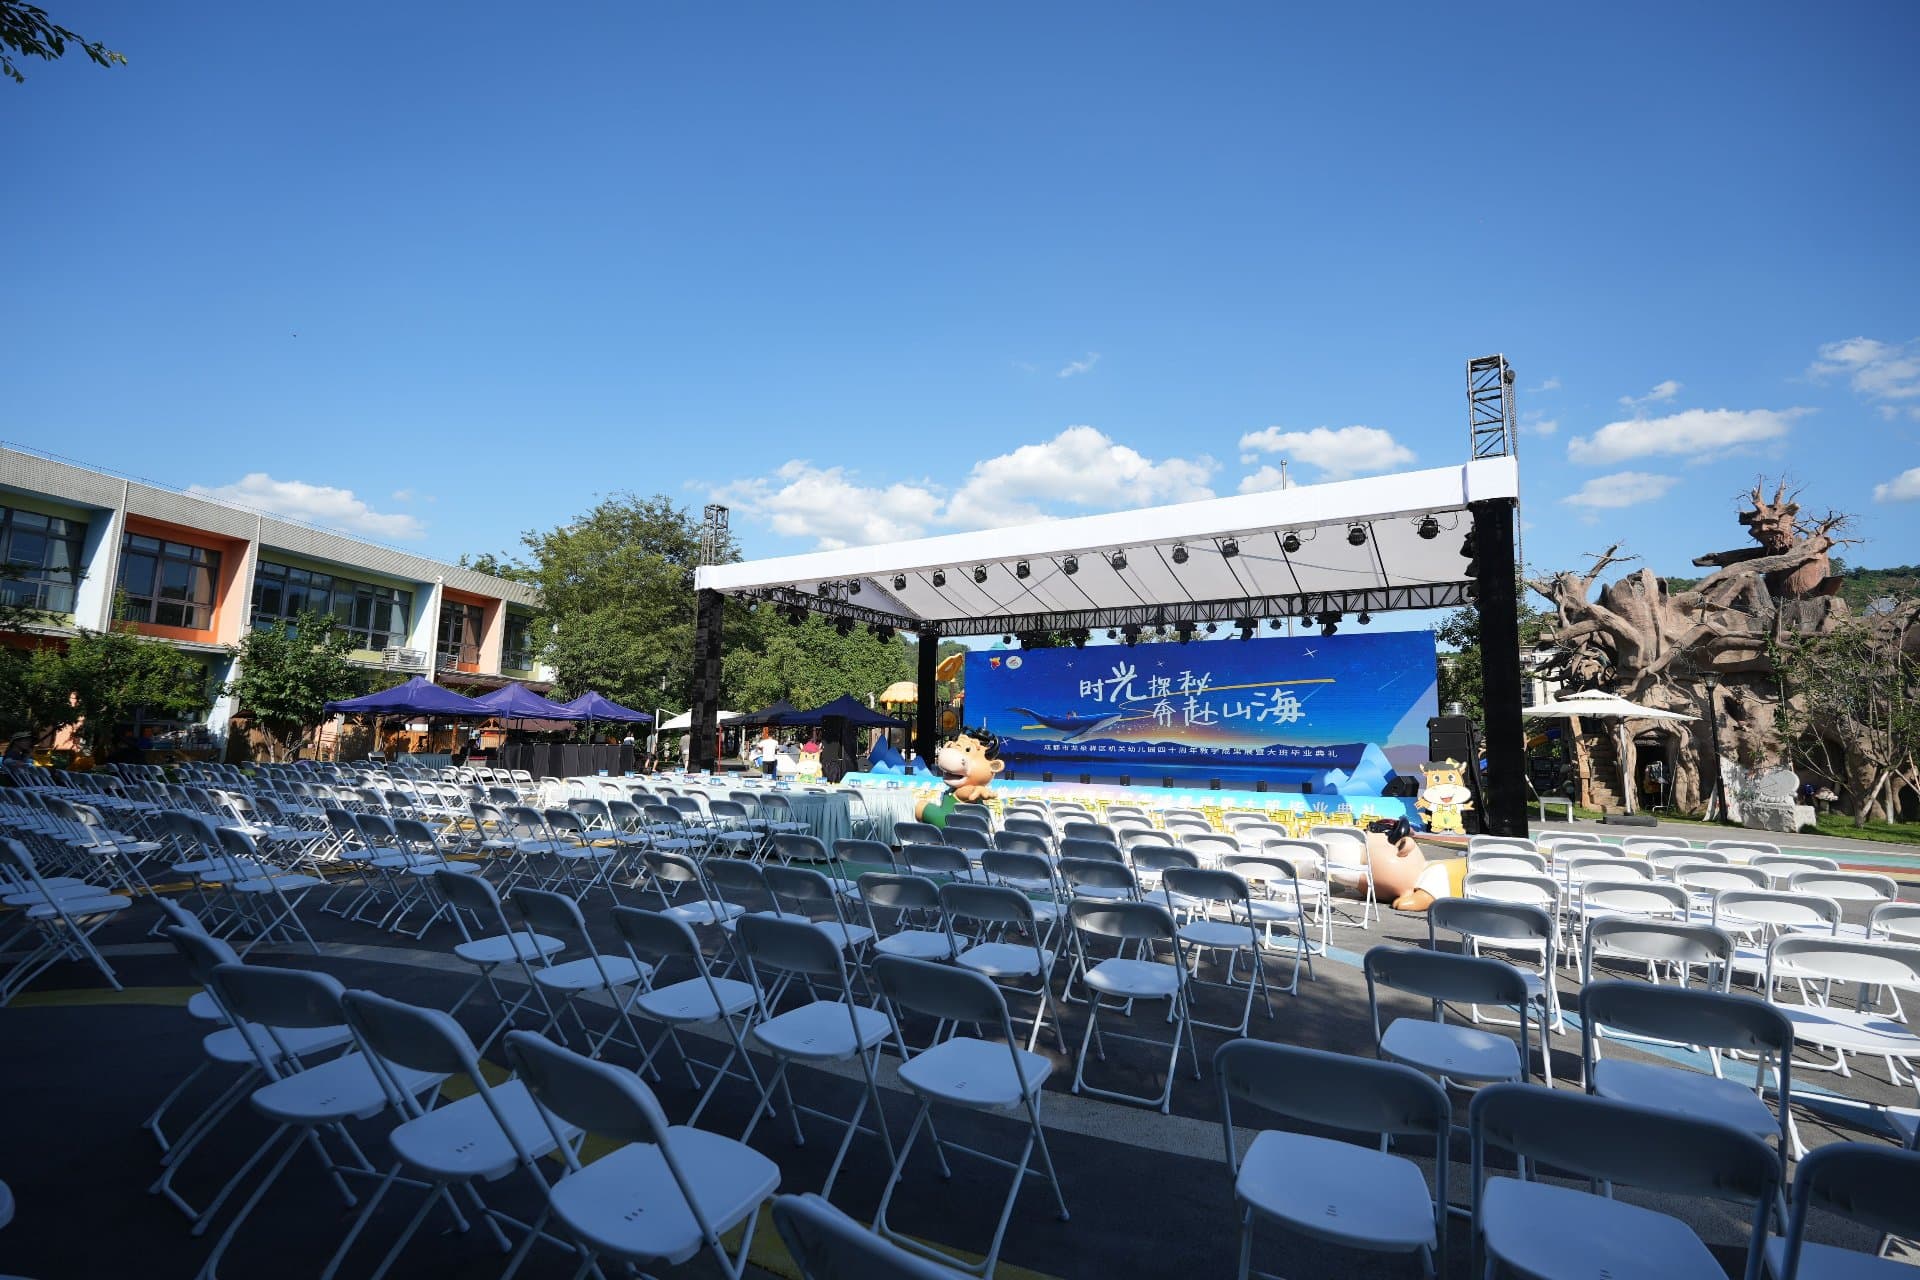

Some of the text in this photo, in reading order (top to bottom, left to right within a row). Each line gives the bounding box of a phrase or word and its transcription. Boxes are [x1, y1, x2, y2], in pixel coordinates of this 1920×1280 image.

[1079, 660, 1212, 703] 时光探秘
[1152, 687, 1306, 728] 奔赴山海
